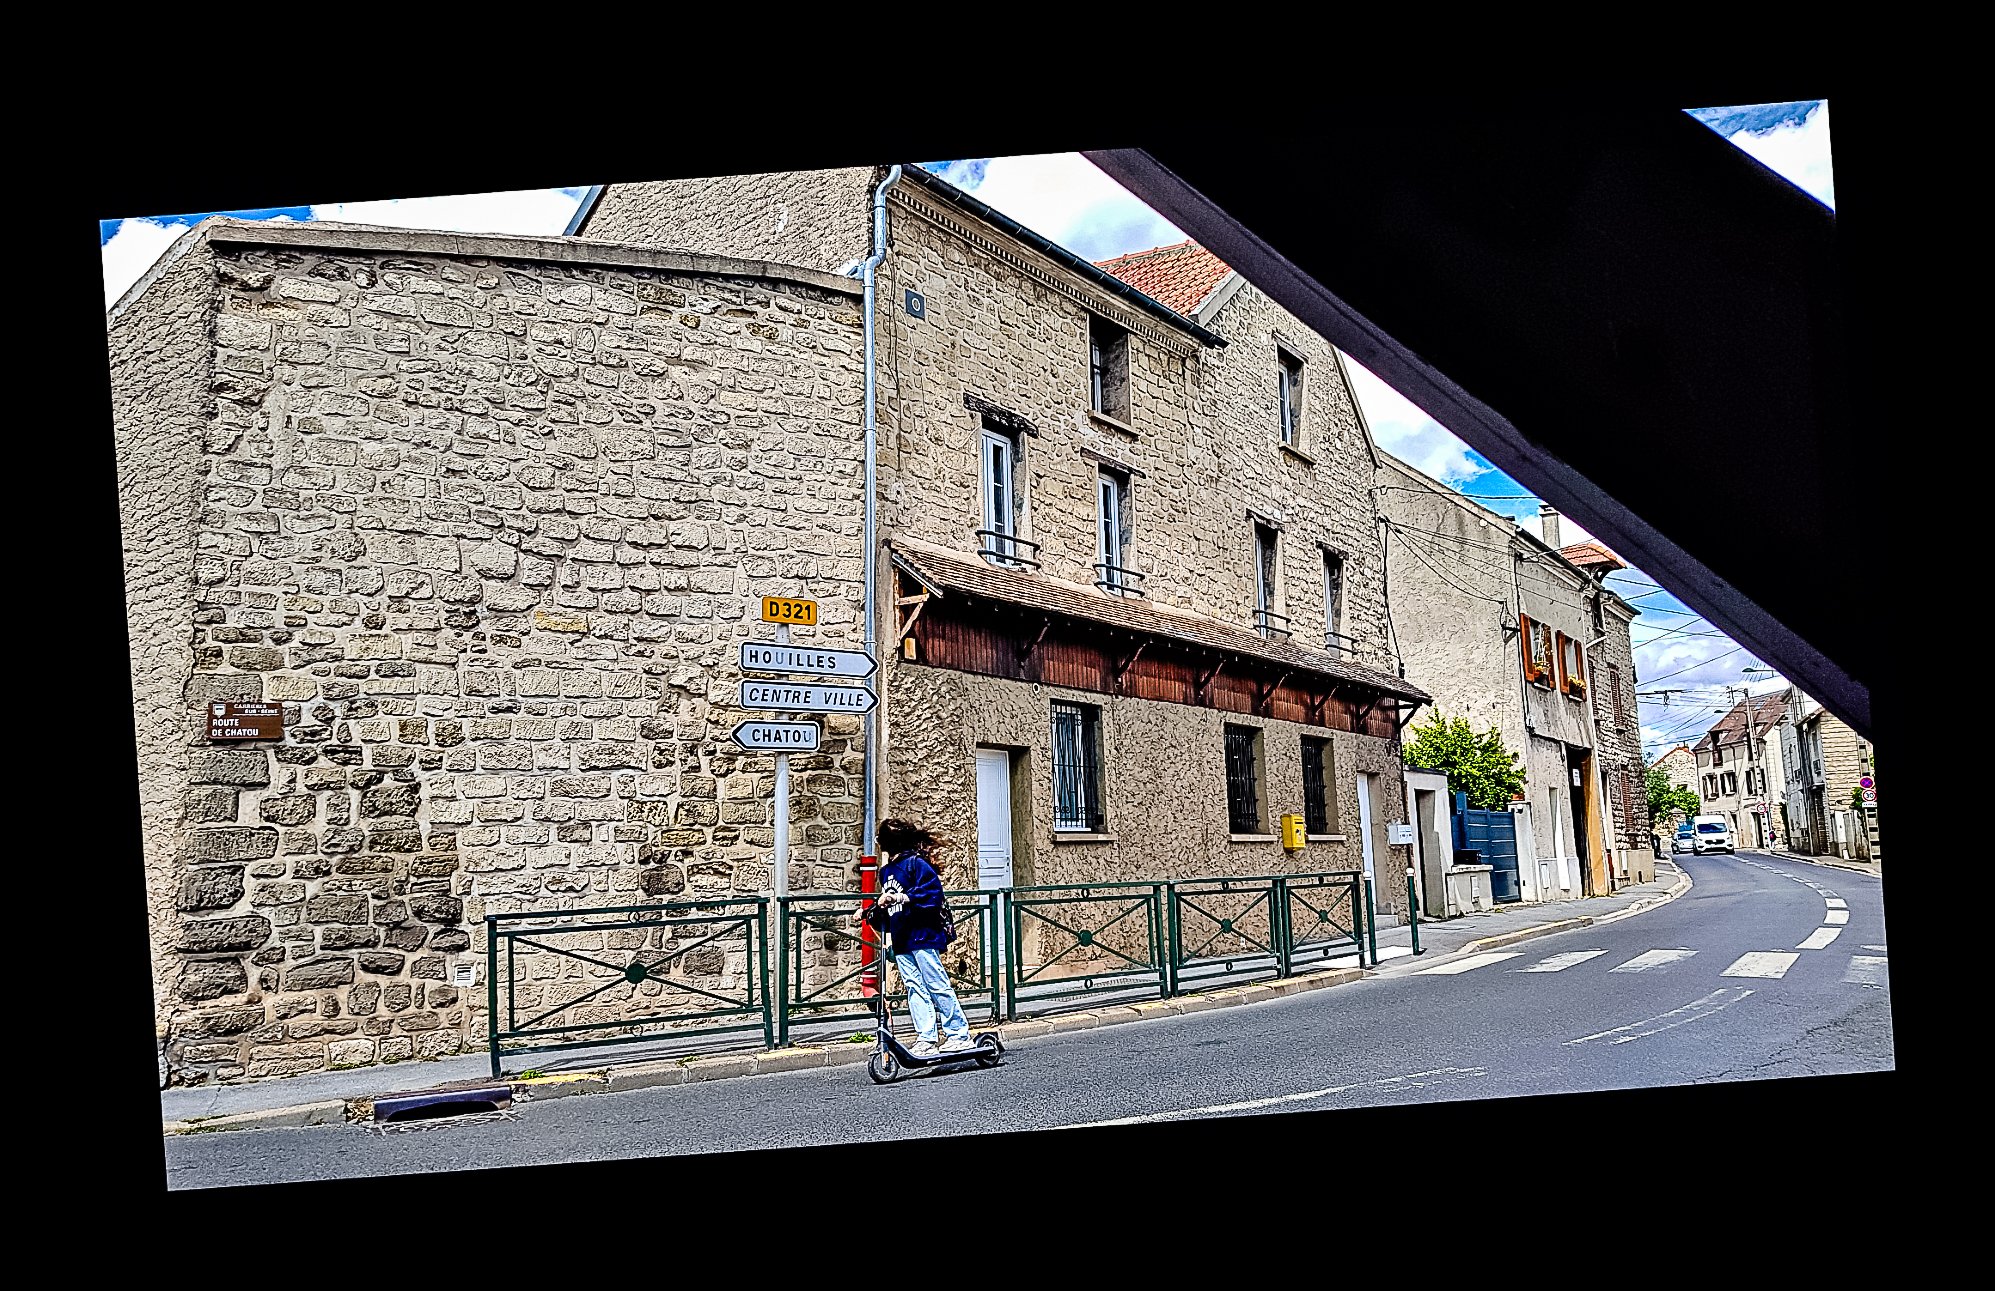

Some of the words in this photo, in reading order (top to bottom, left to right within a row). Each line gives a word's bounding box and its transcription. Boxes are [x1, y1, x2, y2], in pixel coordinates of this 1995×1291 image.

[750, 650, 836, 669] HOUILLES
[749, 688, 812, 704] CENTRE
[823, 692, 864, 707] VILLE
[751, 728, 812, 743] CHATOU
